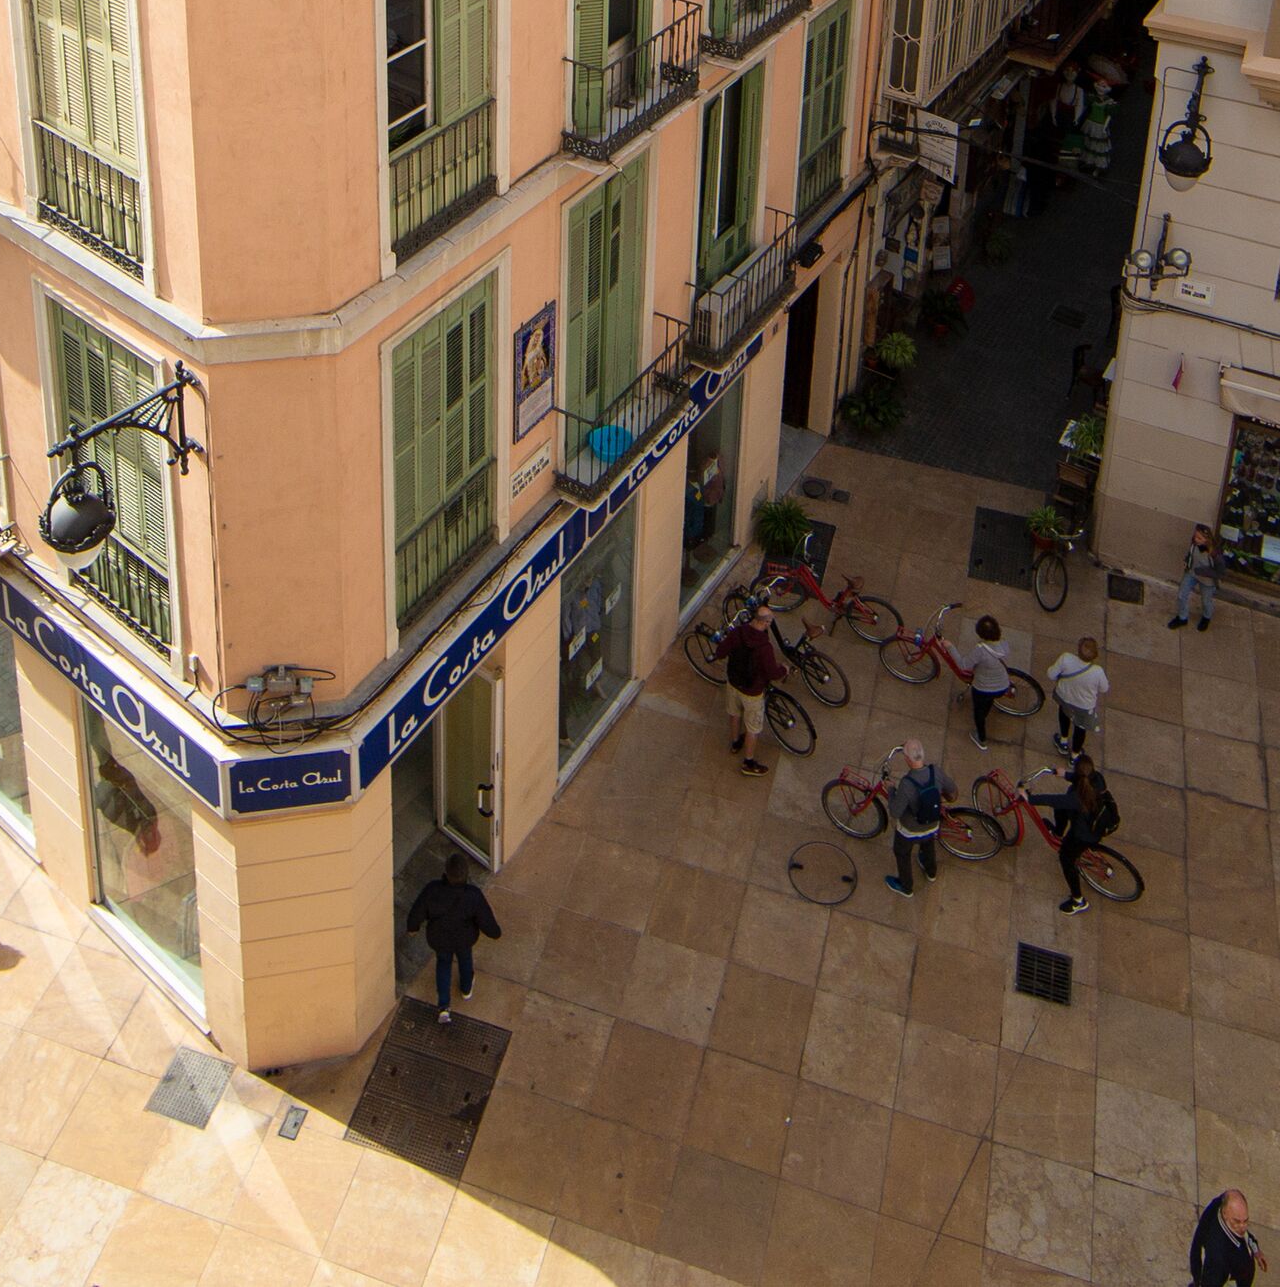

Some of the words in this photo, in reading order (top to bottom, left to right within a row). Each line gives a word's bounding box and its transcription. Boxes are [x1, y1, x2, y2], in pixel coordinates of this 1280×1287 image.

[2, 583, 32, 640] La
[34, 616, 106, 706] Costa
[112, 684, 191, 779] Azul
[389, 713, 418, 755] La
[423, 629, 496, 707] Costa
[503, 530, 566, 621] Azul
[239, 780, 255, 794] La
[257, 777, 299, 791] Costa
[302, 769, 342, 786] Azul
